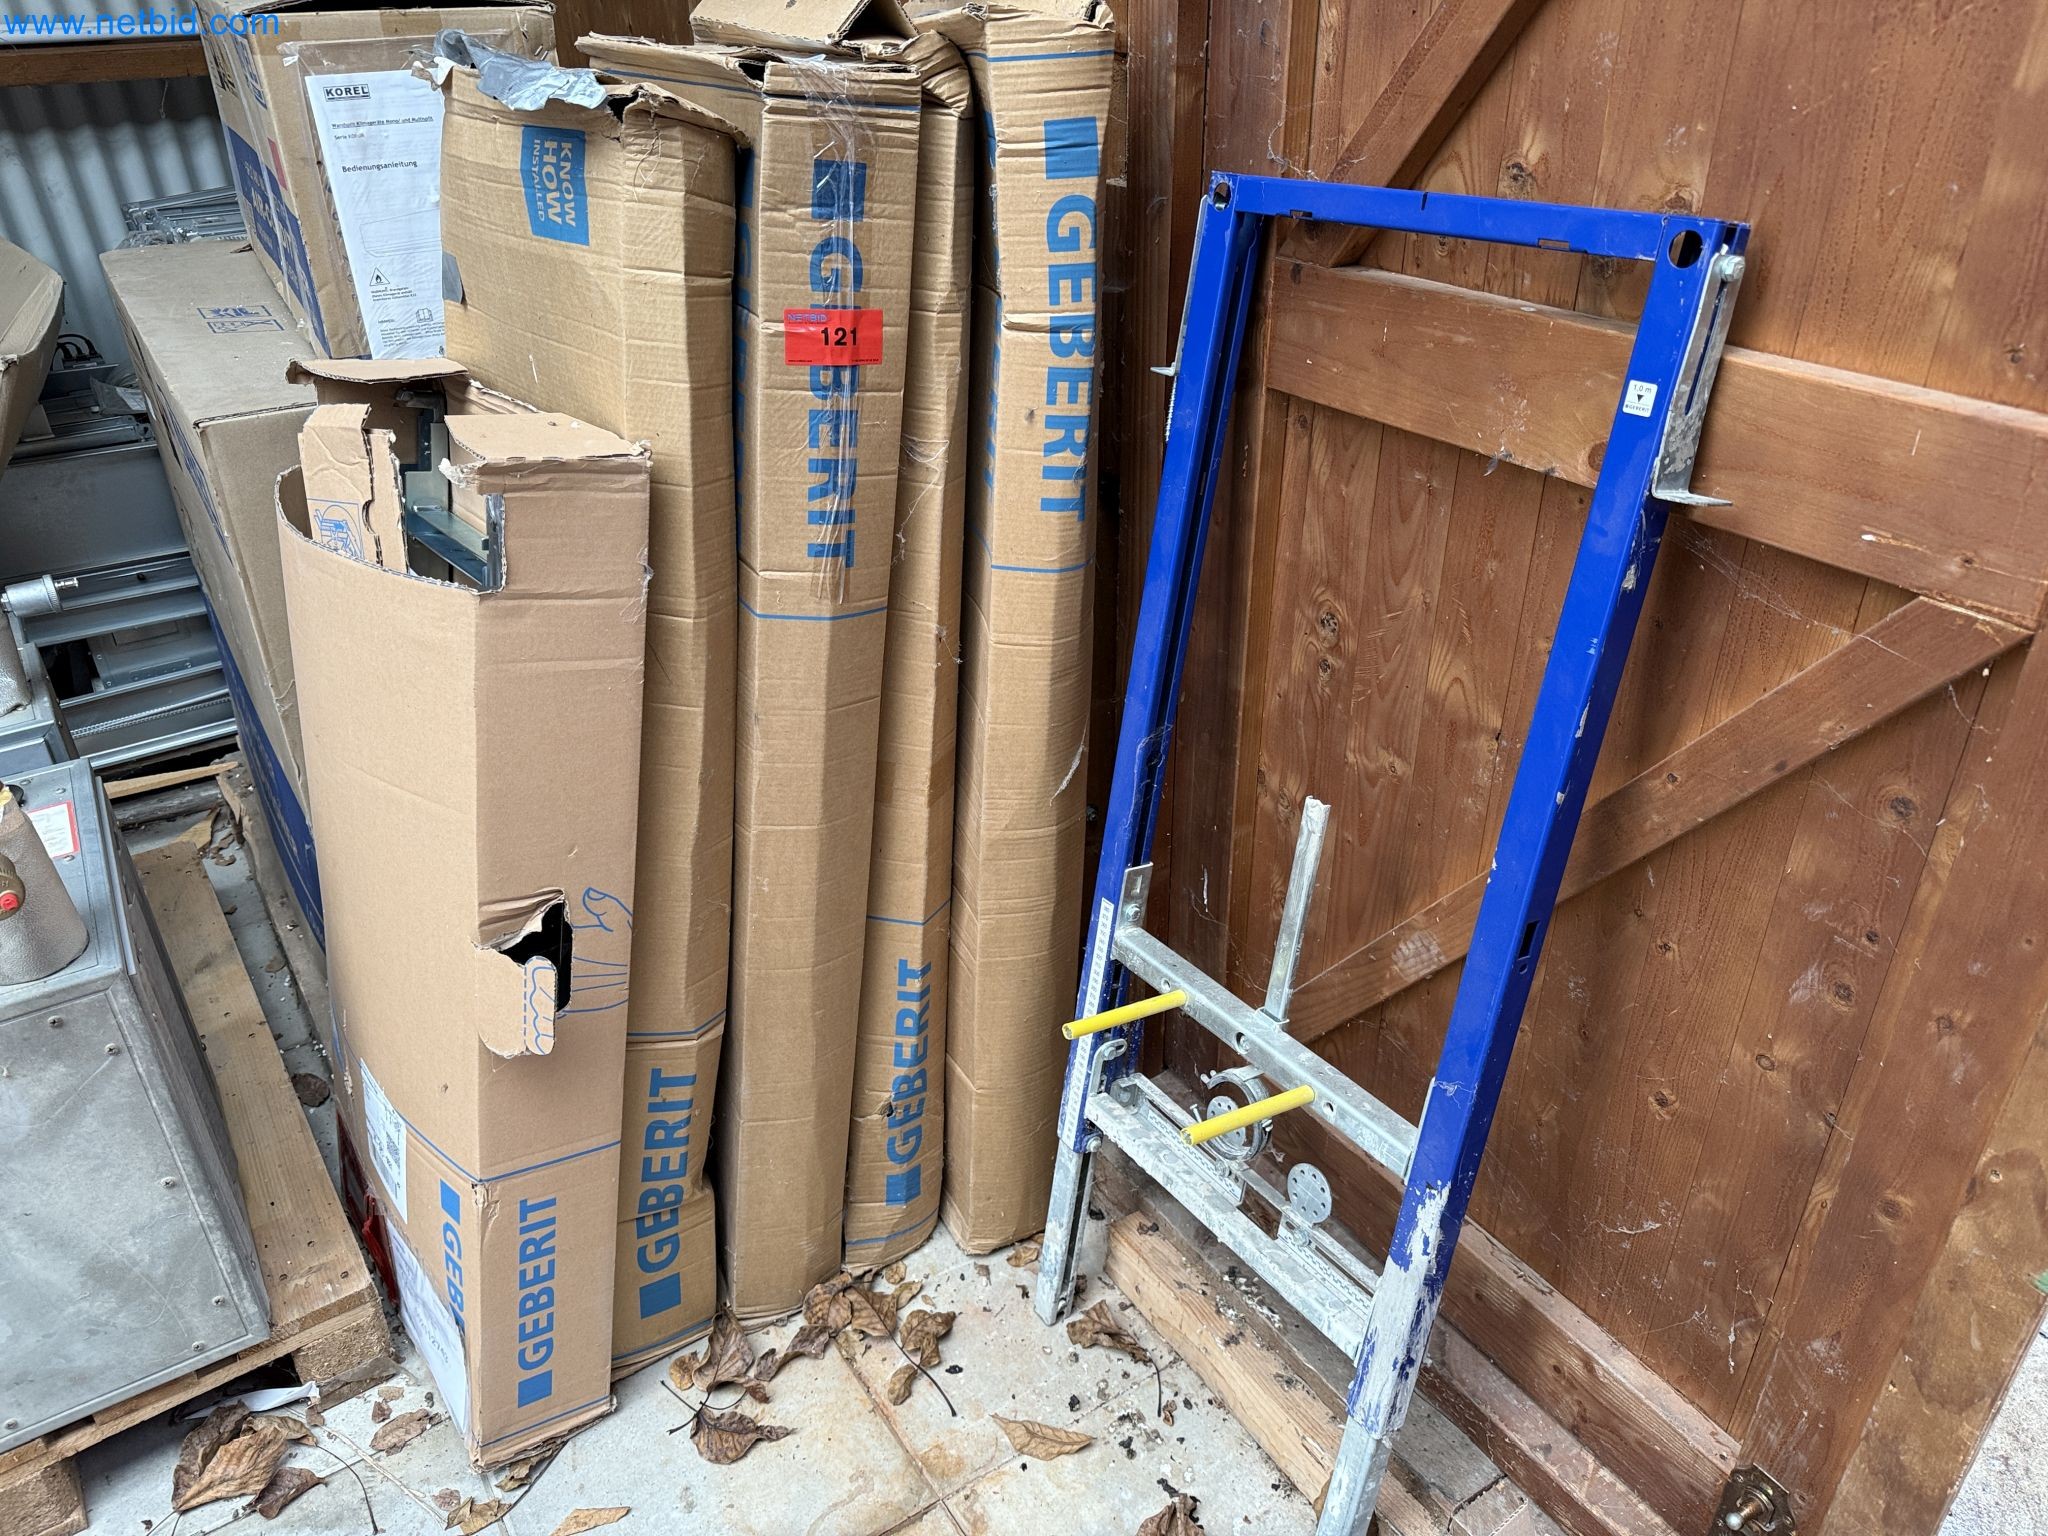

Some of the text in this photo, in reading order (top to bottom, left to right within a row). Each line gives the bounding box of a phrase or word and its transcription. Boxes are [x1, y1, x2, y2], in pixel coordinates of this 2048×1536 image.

[325, 86, 369, 97] KOREL
[342, 160, 418, 173] Bedienungsanleitung
[532, 139, 545, 222] INSTALLED
[542, 140, 562, 225] HOW
[560, 141, 576, 227] KNOW
[821, 327, 857, 346] 121
[1040, 193, 1097, 522] GEBERIT
[808, 236, 863, 568] GBERIT
[886, 958, 932, 1165] GEBERIT
[636, 1067, 697, 1274] GEBERIT
[518, 1197, 557, 1371] GEBERIT
